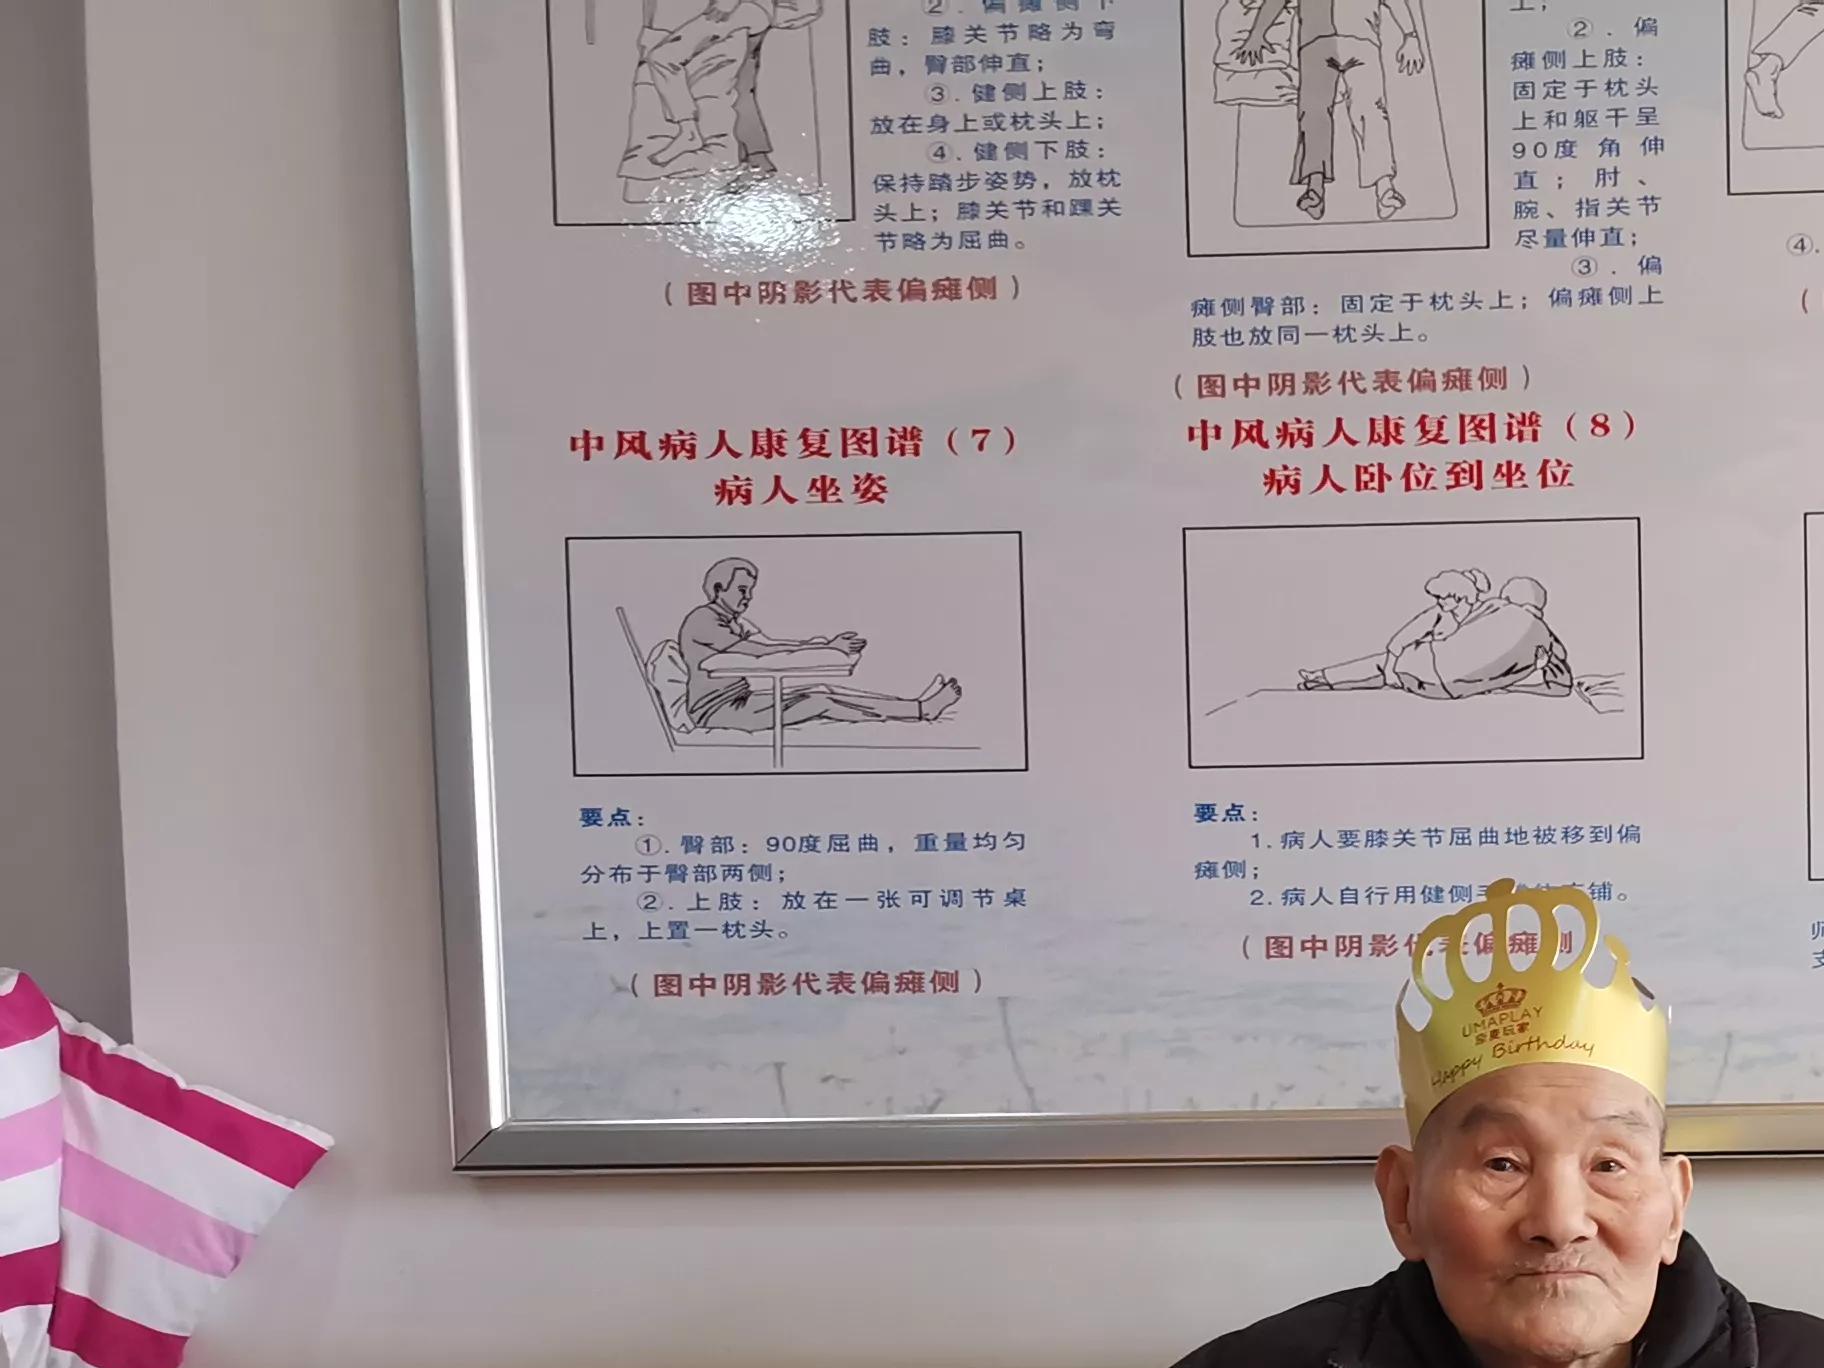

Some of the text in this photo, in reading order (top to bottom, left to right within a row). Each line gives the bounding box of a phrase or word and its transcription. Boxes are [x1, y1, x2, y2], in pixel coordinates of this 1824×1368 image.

[1513, 76, 1658, 100] 固定于枕头
[1513, 106, 1659, 130] 上和躯干呈
[1192, 323, 1430, 347] 肢也放同一枕头上。
[570, 425, 1018, 464] 中风病人康复图谱（7）
[1188, 411, 1637, 450] 中风病人康复图谱（8）
[714, 473, 889, 506] 病人坐姿
[1263, 459, 1576, 496] 病人卧位到坐位
[580, 808, 645, 828] 要点：
[1195, 803, 1259, 823] 要点：
[1462, 1006, 1544, 1037] UMAPLAY
[1431, 1035, 1595, 1086] Happy Birthday
